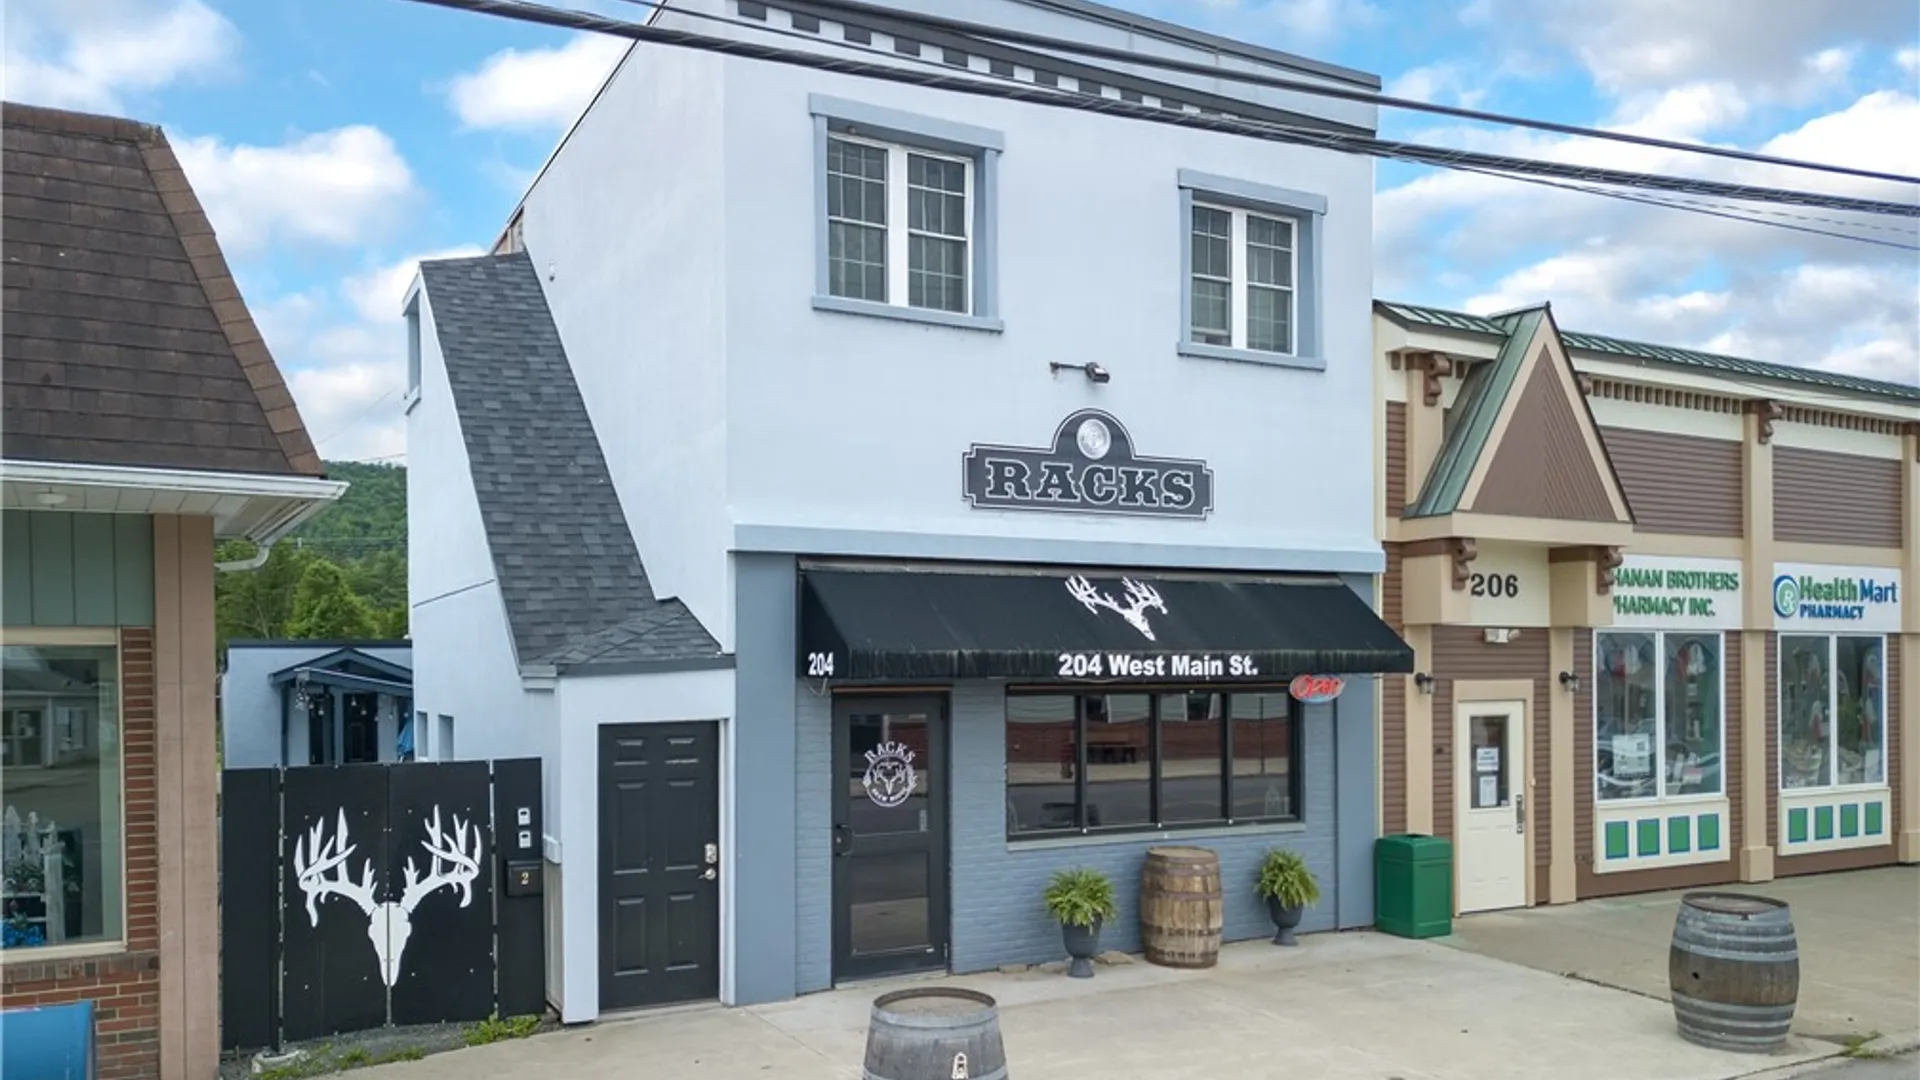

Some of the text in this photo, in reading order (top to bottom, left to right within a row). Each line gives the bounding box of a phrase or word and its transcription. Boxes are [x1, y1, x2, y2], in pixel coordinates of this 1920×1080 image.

[985, 457, 1195, 509] RACKS
[1470, 573, 1519, 598] 206
[1666, 569, 1739, 591] BROTHERS
[1799, 575, 1898, 603] Health Mart
[1688, 597, 1716, 617] INC.
[1799, 603, 1865, 620] PHARMACY
[807, 651, 834, 677] 204
[1058, 653, 1259, 677] 204 West Main St.
[864, 741, 916, 764] RACKS
[521, 871, 529, 885] 2
